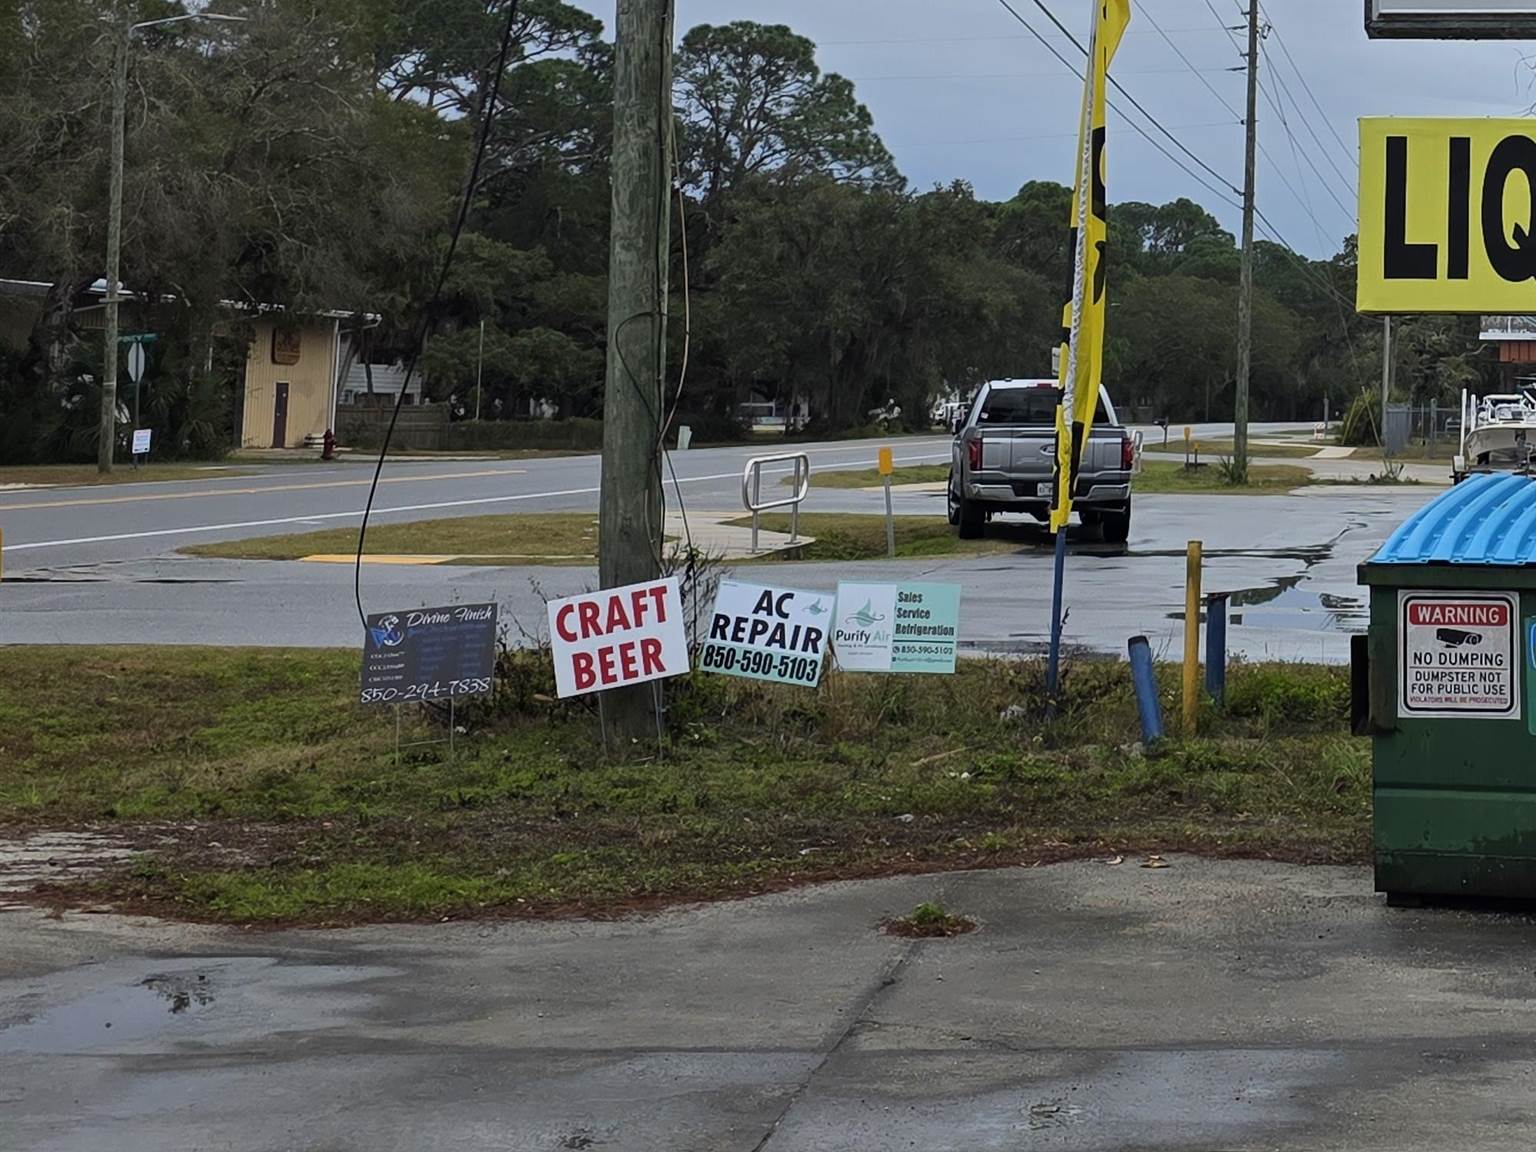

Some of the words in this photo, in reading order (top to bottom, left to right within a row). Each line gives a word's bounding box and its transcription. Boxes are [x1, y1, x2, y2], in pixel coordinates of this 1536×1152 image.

[751, 589, 795, 619] AC
[898, 591, 923, 603] Sales
[406, 611, 450, 628] Divine
[454, 605, 493, 623] Finish
[556, 585, 668, 643] CRAFT
[896, 607, 931, 620] Service
[1417, 605, 1500, 624] WARNING
[709, 613, 823, 654] REPAIR
[836, 630, 871, 644] Purify
[872, 630, 891, 641] Air
[895, 624, 955, 636] Refrigeration
[572, 638, 666, 690] BEER
[703, 644, 819, 682] 850-590-5103
[1413, 651, 1433, 665] NO
[1438, 652, 1504, 667] DUMPING
[1415, 670, 1475, 683] DUMPSTER
[1479, 672, 1502, 683] NOT
[361, 676, 491, 703] 850-294-7838
[1411, 683, 1433, 694] FOR
[1438, 683, 1479, 695] PUBLIC
[1483, 684, 1506, 696] USE
